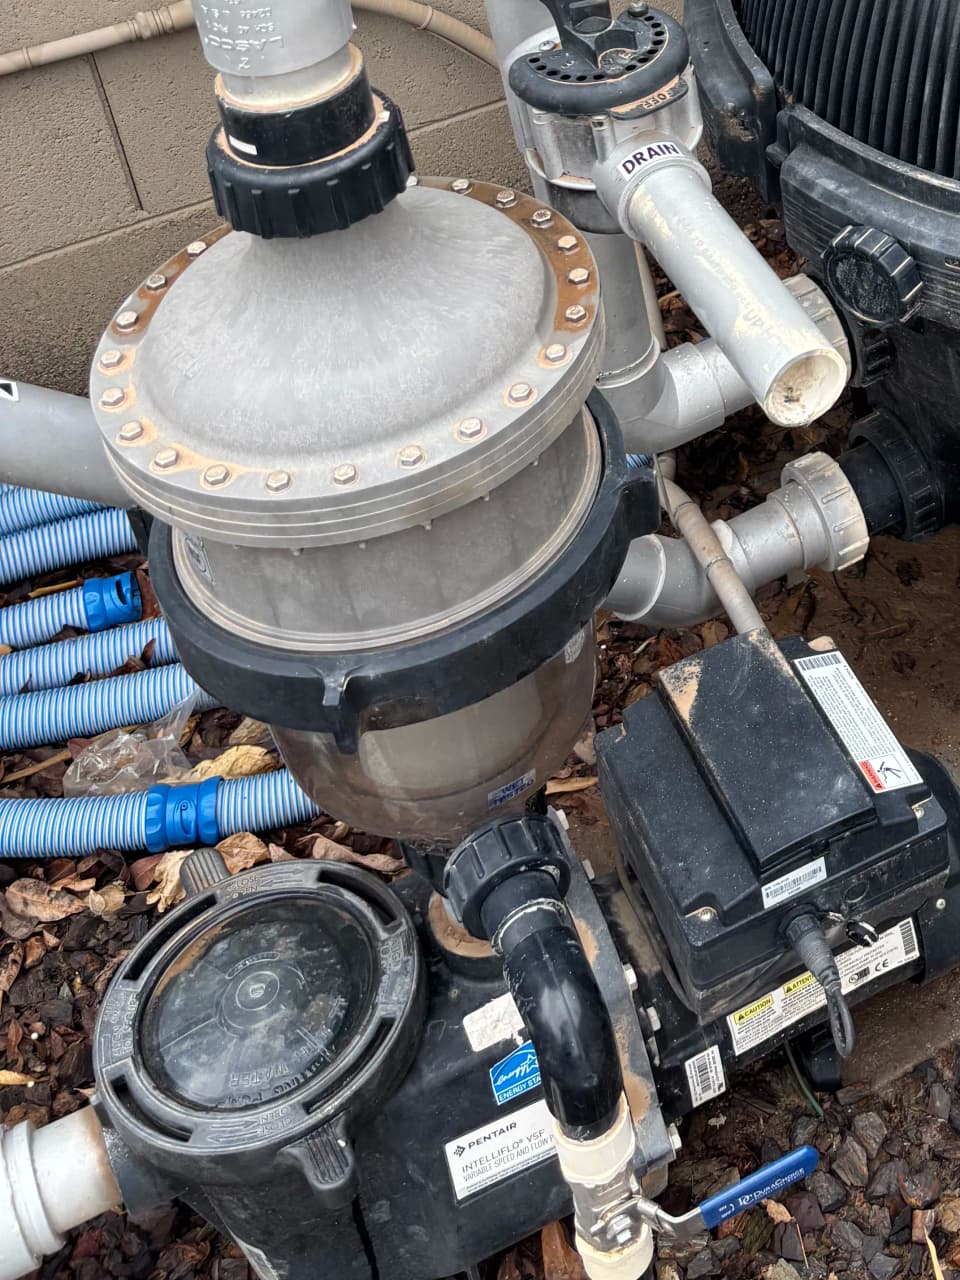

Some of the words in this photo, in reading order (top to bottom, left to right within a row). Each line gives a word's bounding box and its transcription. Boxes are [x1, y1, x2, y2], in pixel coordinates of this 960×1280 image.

[621, 141, 680, 175] DRAIN
[792, 974, 814, 990] ATTENT
[744, 999, 771, 1017] CAUTION
[229, 1062, 289, 1088] WATER
[498, 1083, 527, 1101] ENERGY
[527, 1075, 541, 1088] STA
[468, 1122, 517, 1149] PENTAIR
[526, 1128, 545, 1143] VSF
[516, 1144, 529, 1158] AND
[531, 1137, 550, 1152] FLOW
